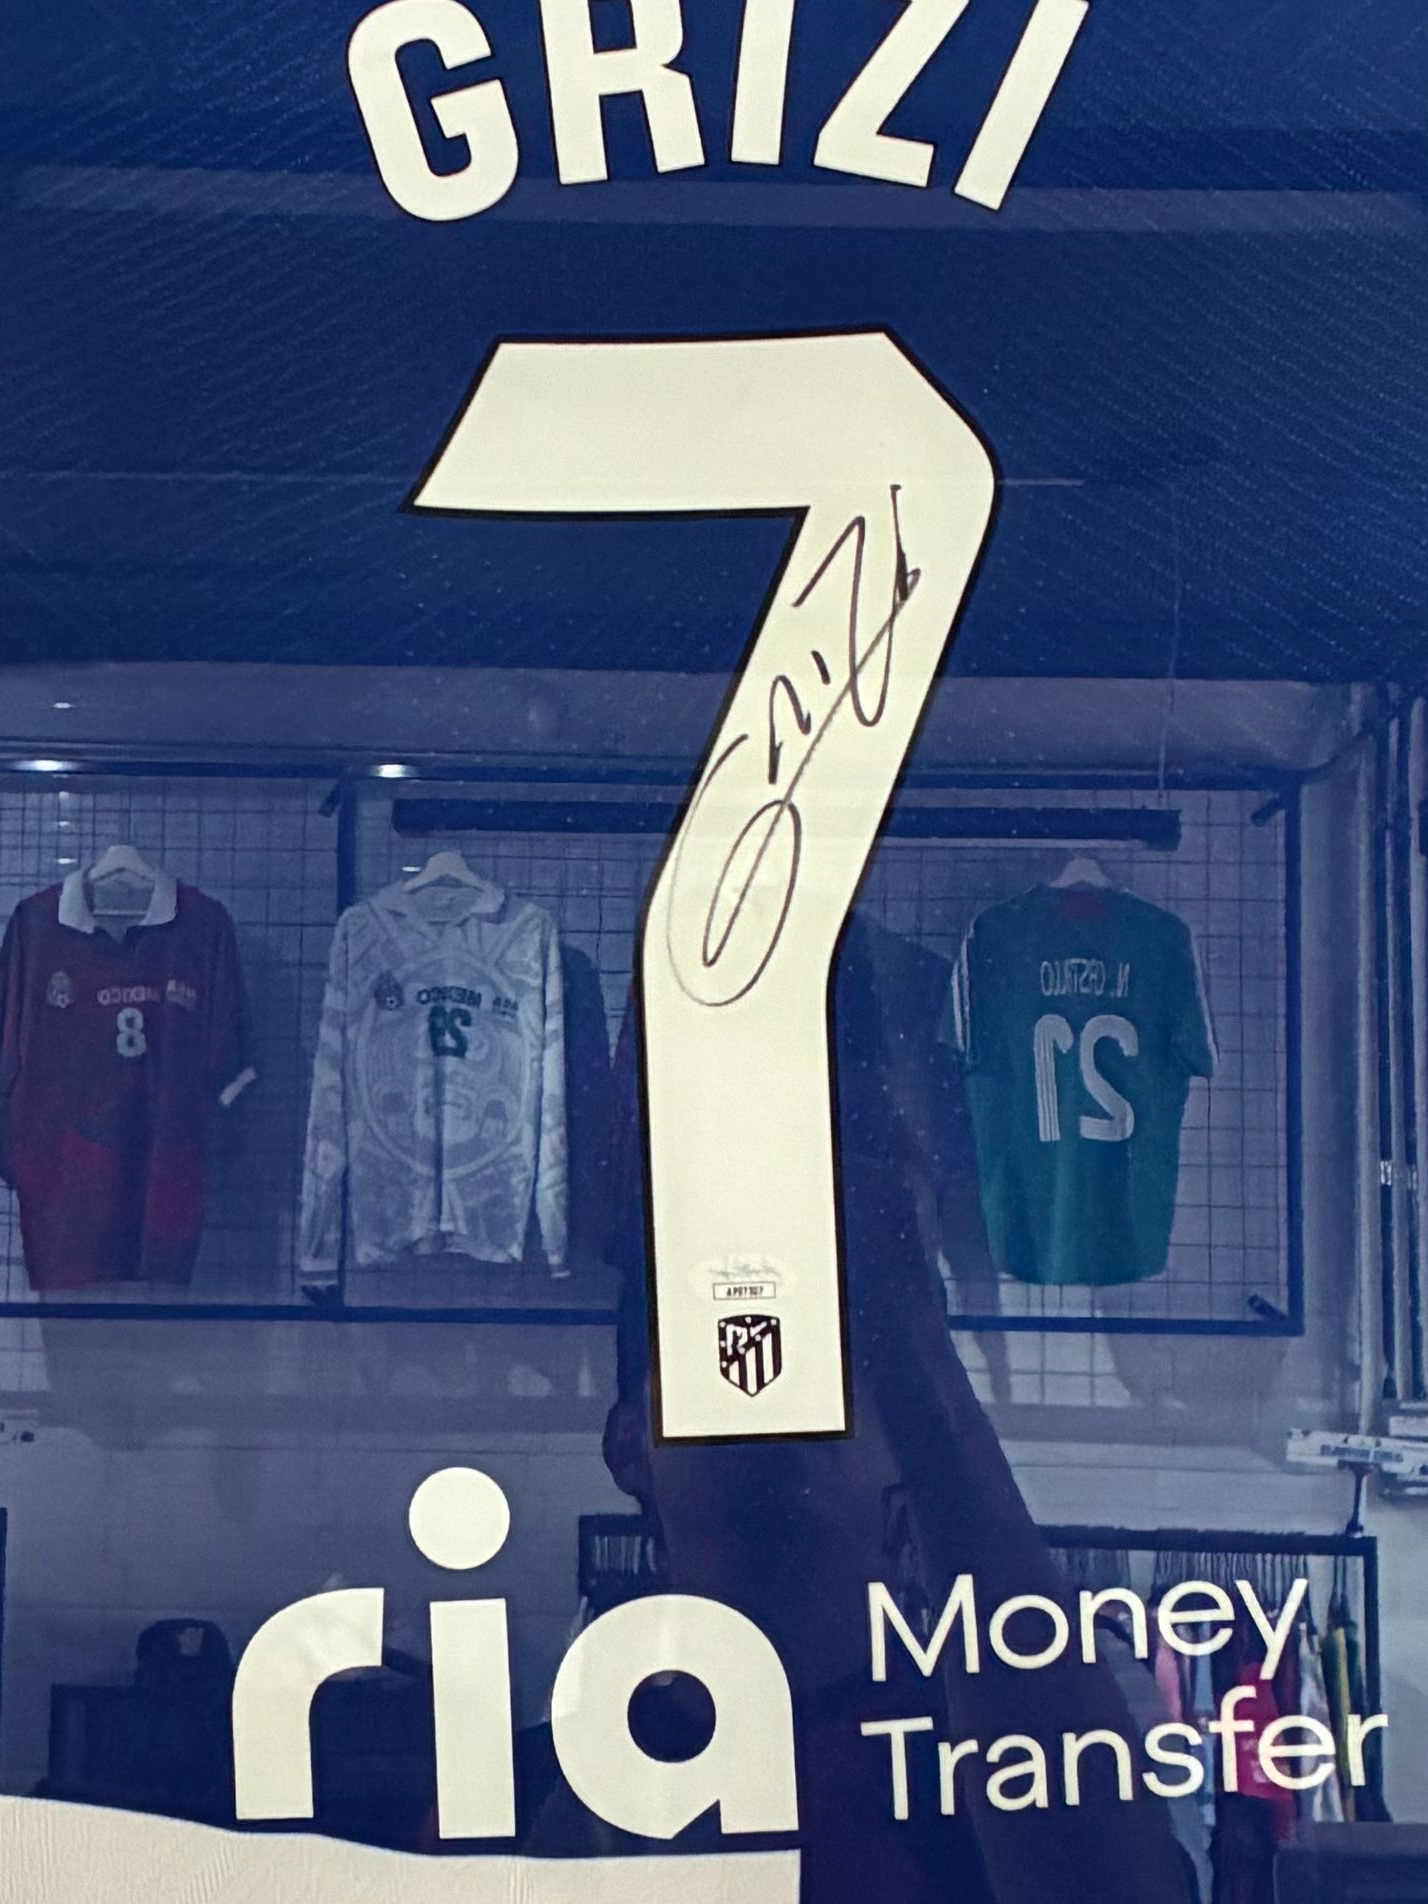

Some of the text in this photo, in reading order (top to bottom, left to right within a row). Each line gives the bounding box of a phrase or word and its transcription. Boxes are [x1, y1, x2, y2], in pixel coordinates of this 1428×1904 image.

[410, 330, 996, 1438] 7
[232, 1467, 800, 1840] ria
[860, 1686, 1389, 1822] Transfer
[869, 1576, 1309, 1683] Money
